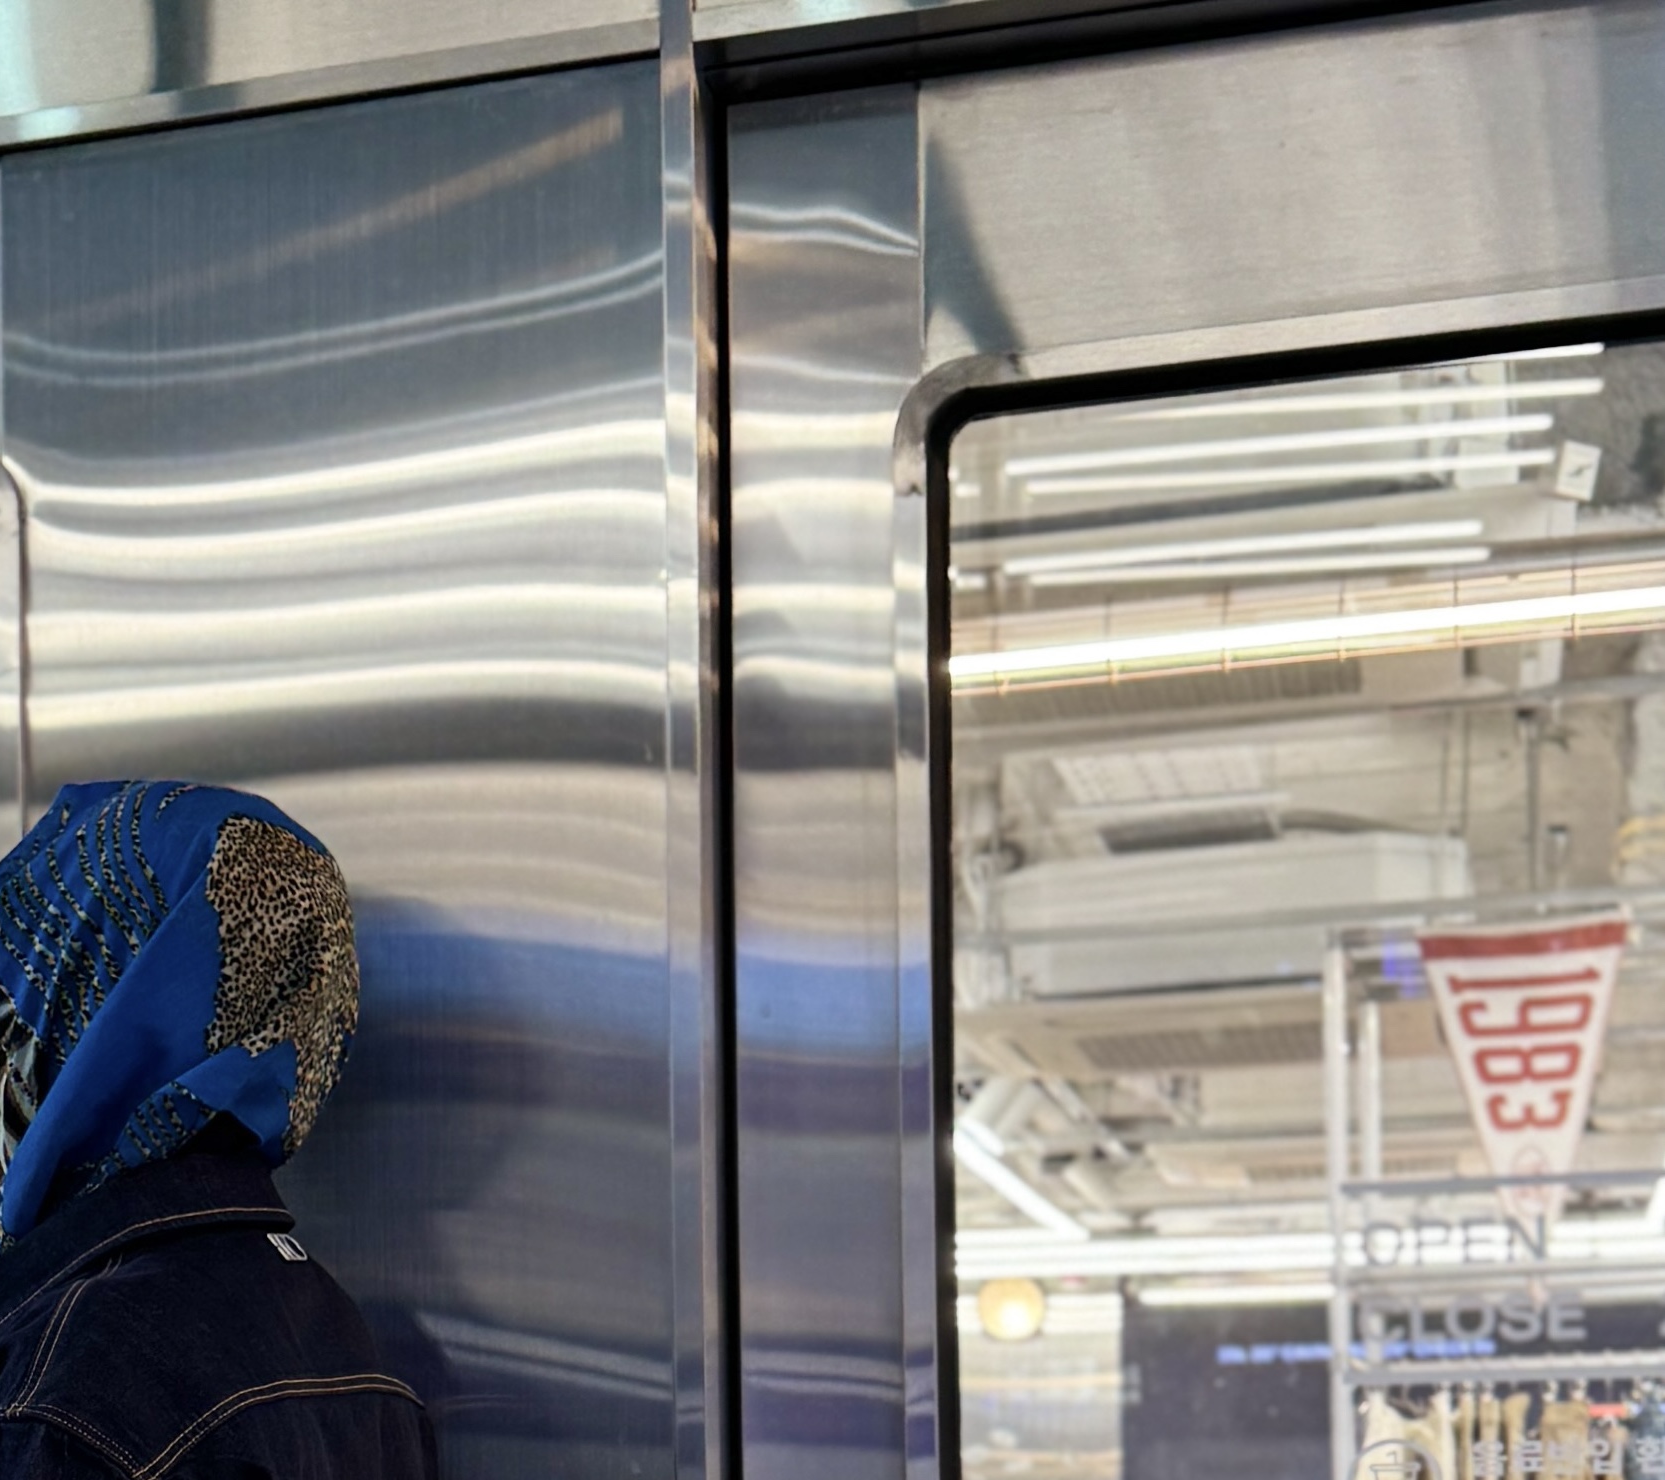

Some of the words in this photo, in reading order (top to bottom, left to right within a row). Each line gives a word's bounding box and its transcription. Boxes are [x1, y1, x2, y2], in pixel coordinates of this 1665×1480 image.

[1445, 967, 1601, 1131] 1983
[1364, 1216, 1545, 1265] OPEN
[1358, 1296, 1586, 1342] CLOSE
